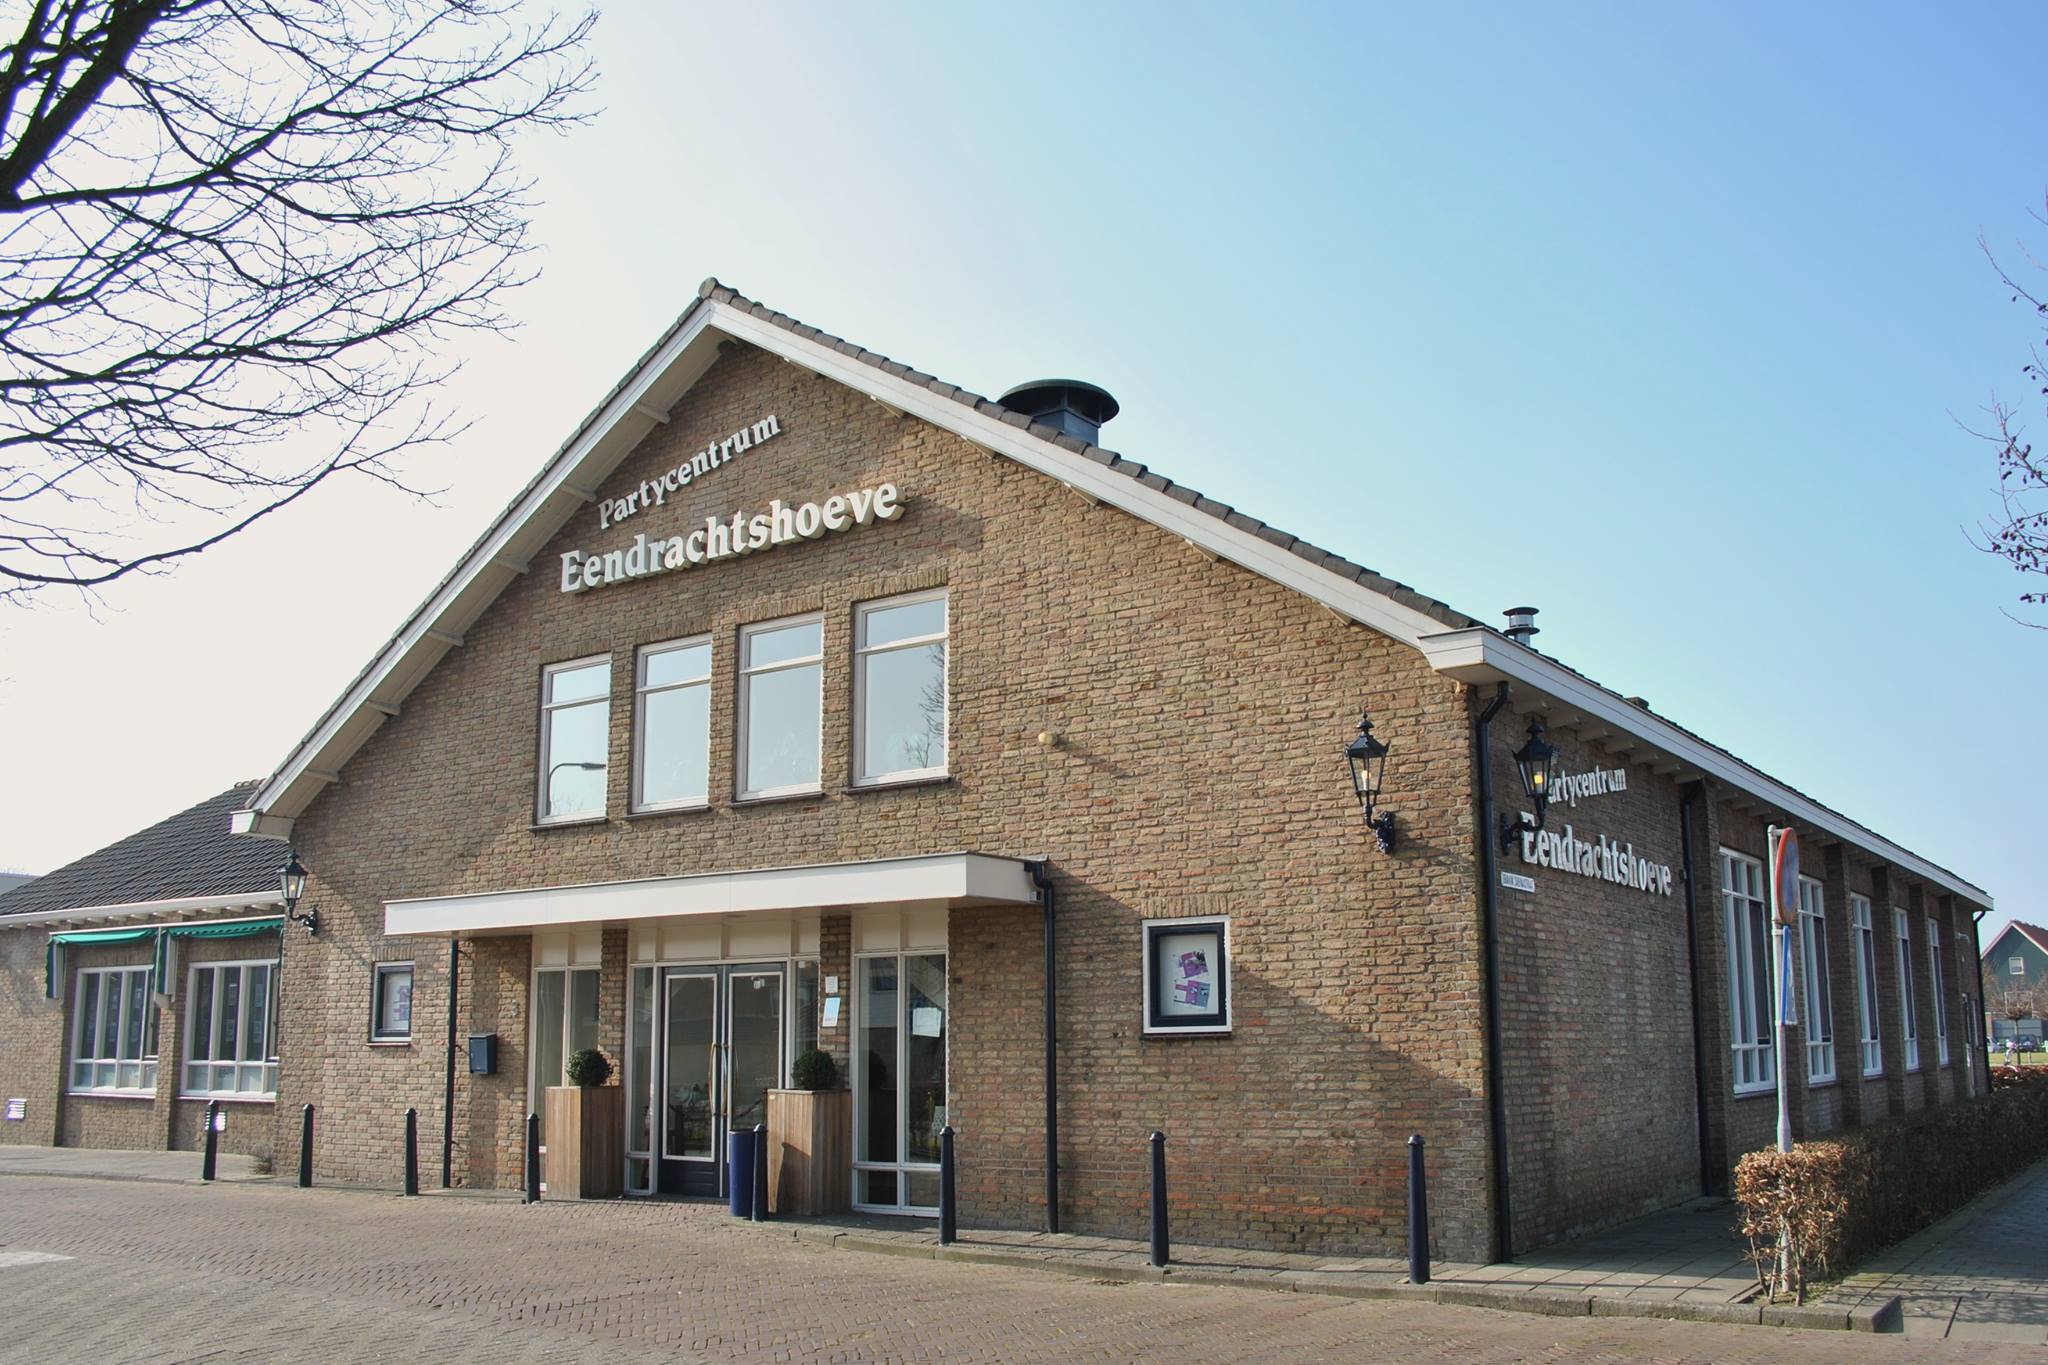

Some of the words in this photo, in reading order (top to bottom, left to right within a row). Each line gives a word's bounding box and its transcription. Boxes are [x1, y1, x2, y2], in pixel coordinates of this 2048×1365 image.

[598, 414, 781, 530] Partycentrum
[560, 482, 903, 593] Eendrachtshoeve
[1547, 764, 1627, 807] artycentrum
[1520, 810, 1672, 896] Eendrachtshoeve
